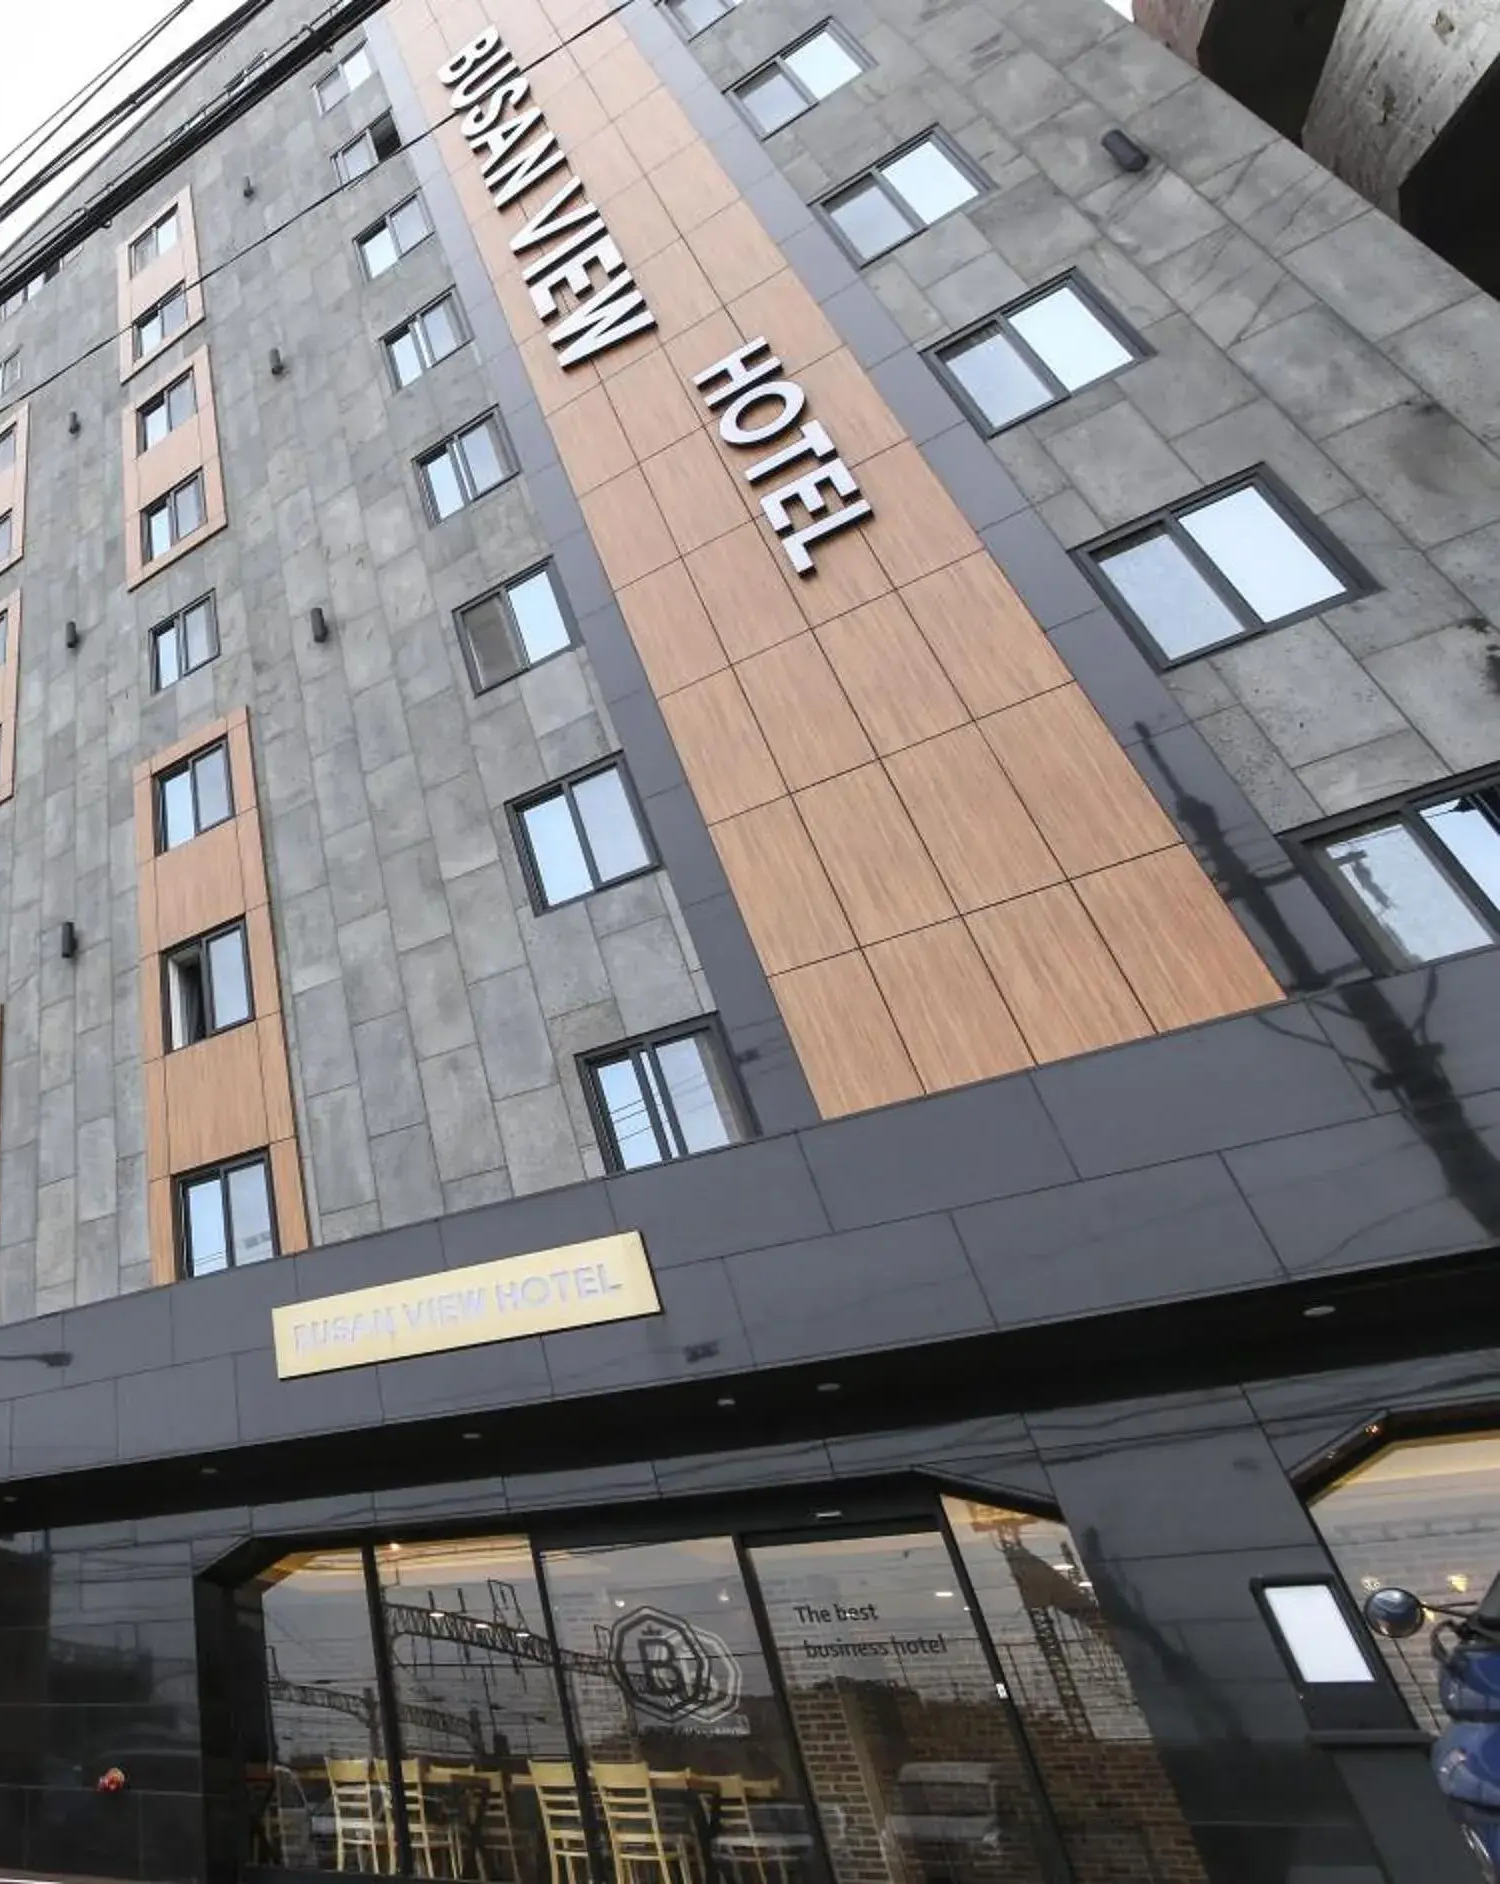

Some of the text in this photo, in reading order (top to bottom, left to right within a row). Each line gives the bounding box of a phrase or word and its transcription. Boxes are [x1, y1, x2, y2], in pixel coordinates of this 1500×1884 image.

[437, 23, 875, 579] BUSAN VIEW HOTEL
[403, 1285, 486, 1331] VIEW
[494, 1264, 624, 1315] HOTEL
[793, 1603, 879, 1624] The best
[638, 1638, 687, 1696] B
[803, 1633, 948, 1659] business hotel
